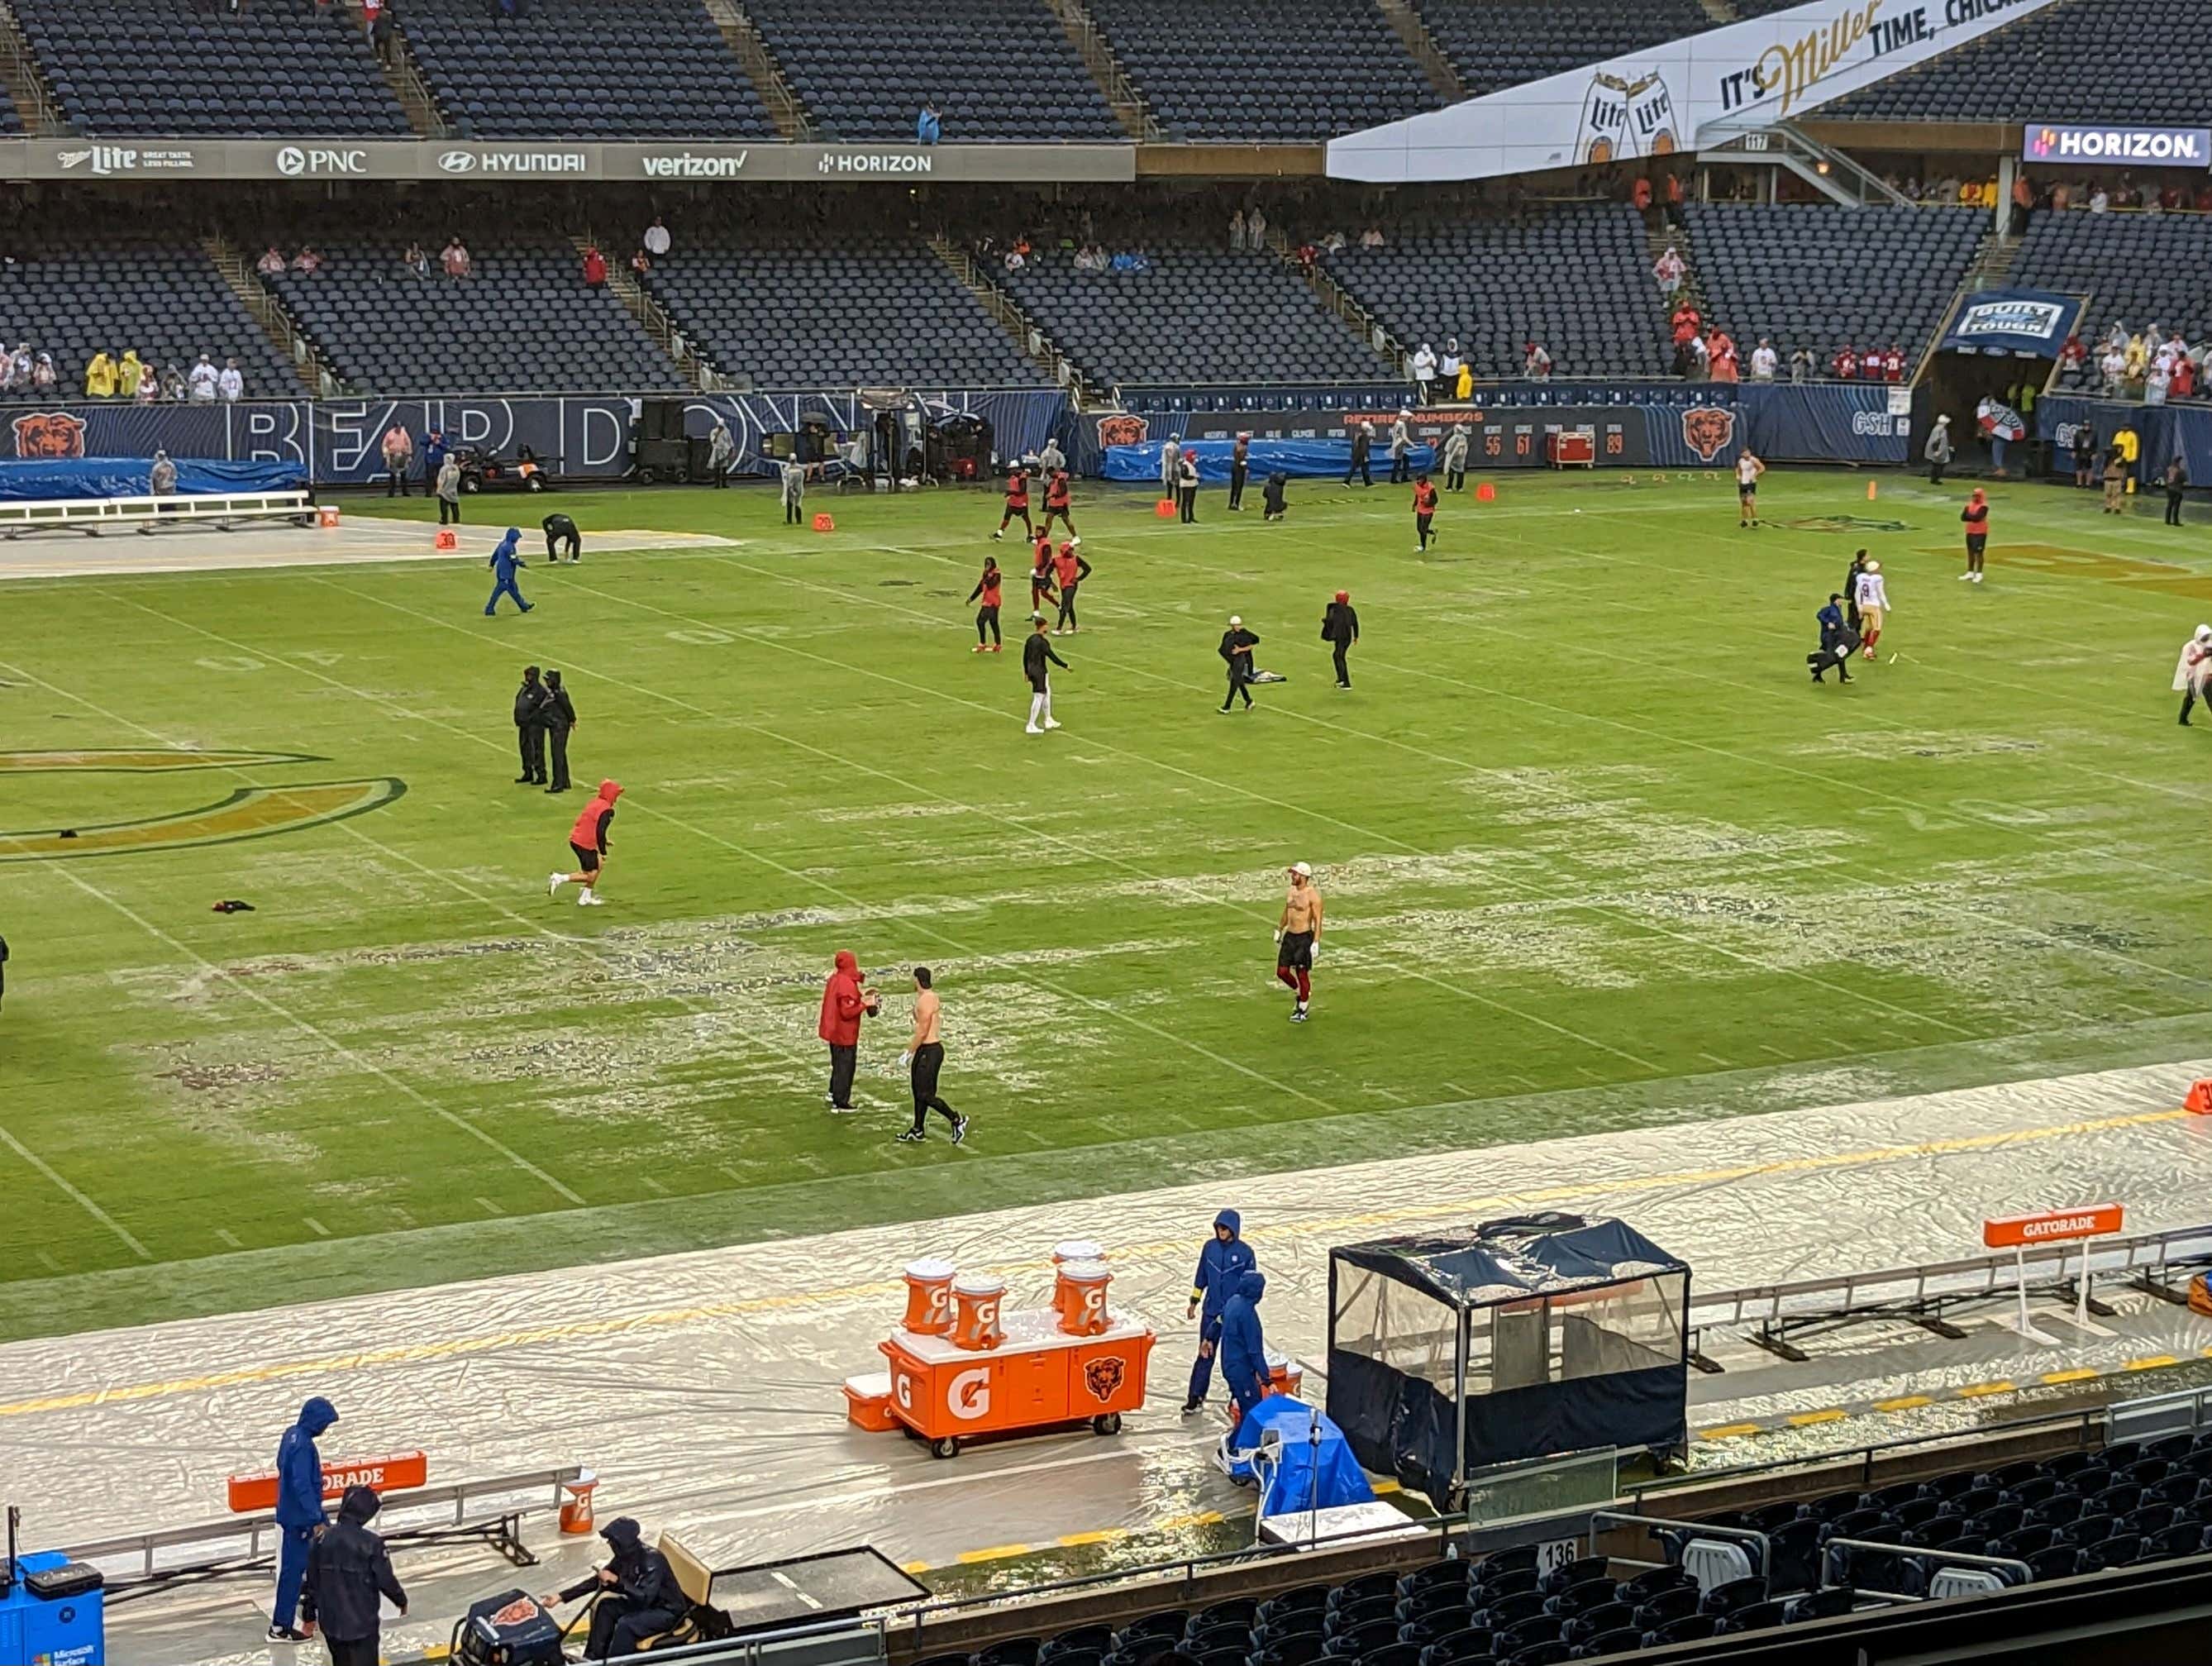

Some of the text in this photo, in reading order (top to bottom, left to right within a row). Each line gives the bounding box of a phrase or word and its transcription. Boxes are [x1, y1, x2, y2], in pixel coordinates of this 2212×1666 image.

[1868, 7, 1935, 57] TIME,
[1590, 97, 1627, 132] Lite
[1635, 92, 1668, 135] Lite
[1747, 135, 1765, 150] 117
[2060, 132, 2195, 158] HORIZON
[92, 146, 137, 174] Lite
[308, 150, 366, 173] PNC
[482, 154, 586, 172] HYUNDAI
[643, 153, 737, 176] verizon
[837, 155, 932, 173] HORIZON
[1852, 411, 1891, 436] GSH
[2199, 1084, 2212, 1110] 3
[2023, 1215, 2095, 1237] GATORADE
[930, 1288, 947, 1308] G
[1085, 1289, 1102, 1309] G
[976, 1302, 994, 1323] G
[896, 1374, 911, 1409] G
[947, 1368, 990, 1419] G
[322, 1468, 384, 1490] ORADE
[1546, 1541, 1574, 1568] 136
